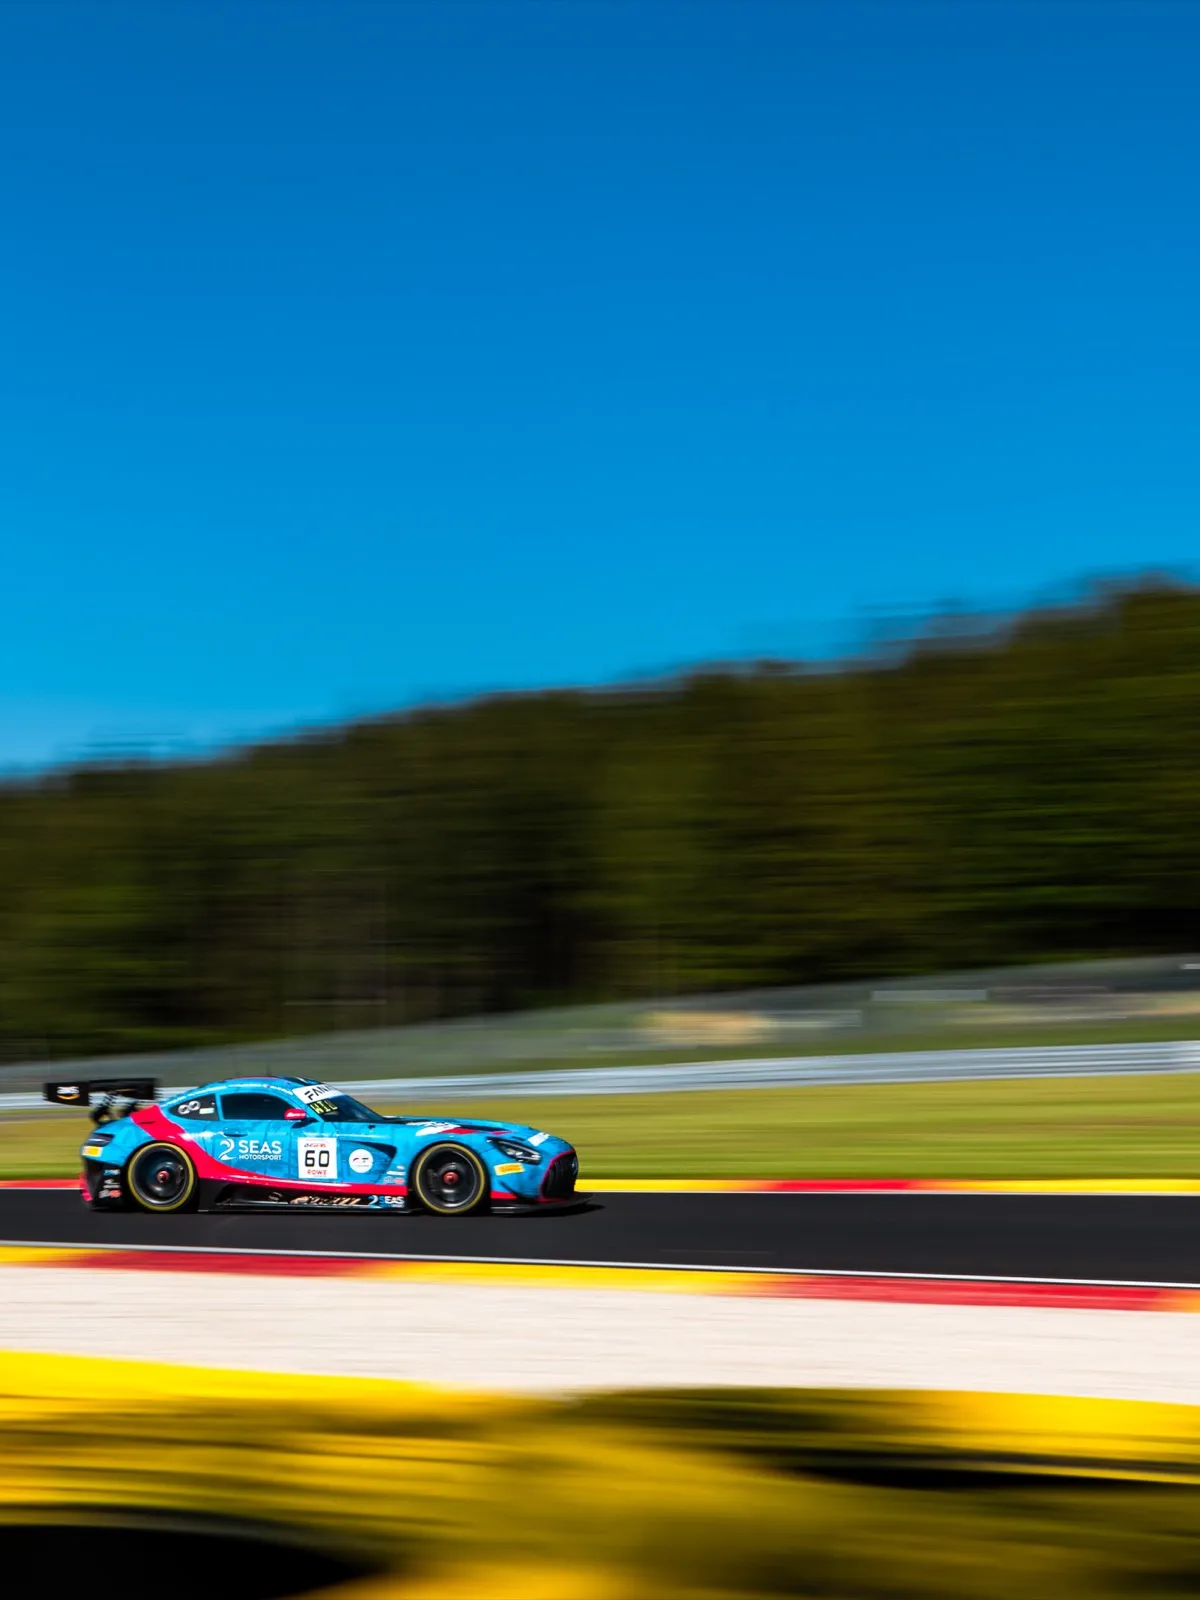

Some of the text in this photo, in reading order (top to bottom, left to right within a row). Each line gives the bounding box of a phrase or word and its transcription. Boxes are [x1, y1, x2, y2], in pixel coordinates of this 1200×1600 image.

[238, 1140, 282, 1154] SEAS
[305, 1150, 330, 1167] 60
[380, 1196, 404, 1205] SEAS
